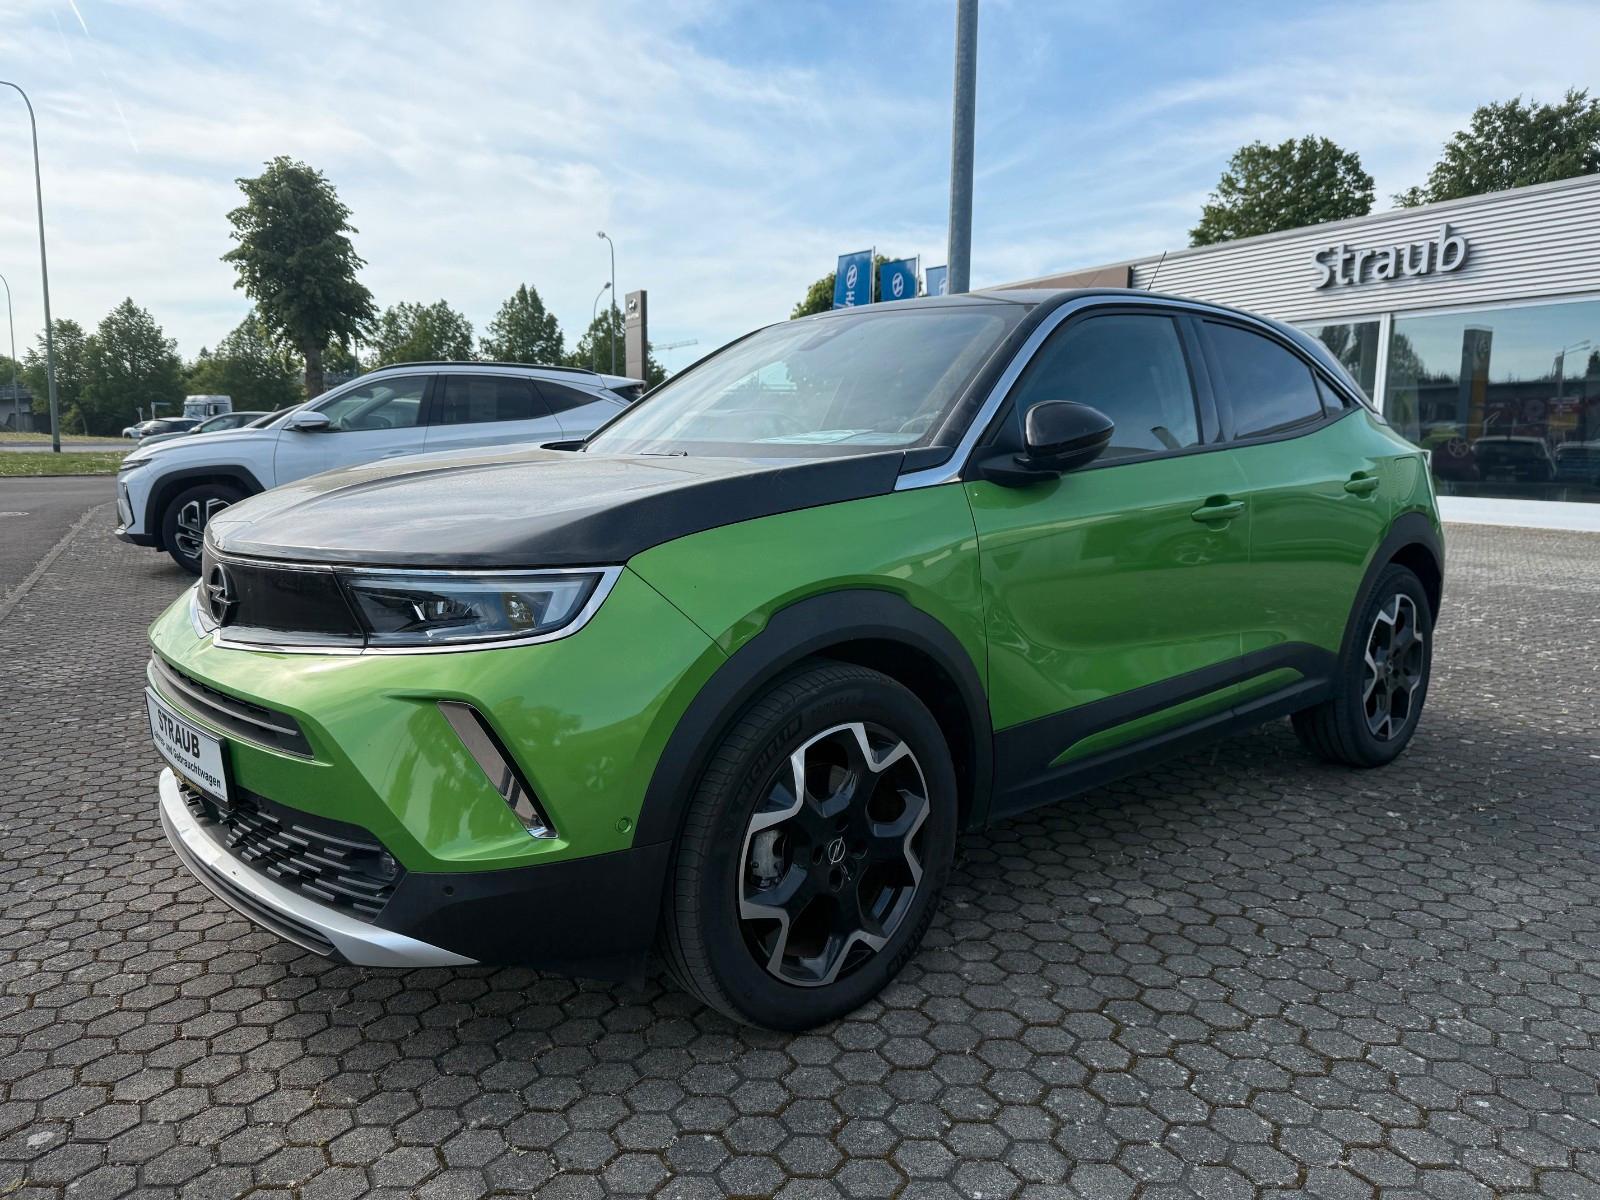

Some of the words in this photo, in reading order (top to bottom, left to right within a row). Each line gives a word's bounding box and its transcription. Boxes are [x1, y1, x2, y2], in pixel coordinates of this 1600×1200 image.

[1310, 223, 1468, 289] Straub
[157, 709, 200, 759] STRAUB
[173, 748, 221, 789] Gebrauchtwagen
